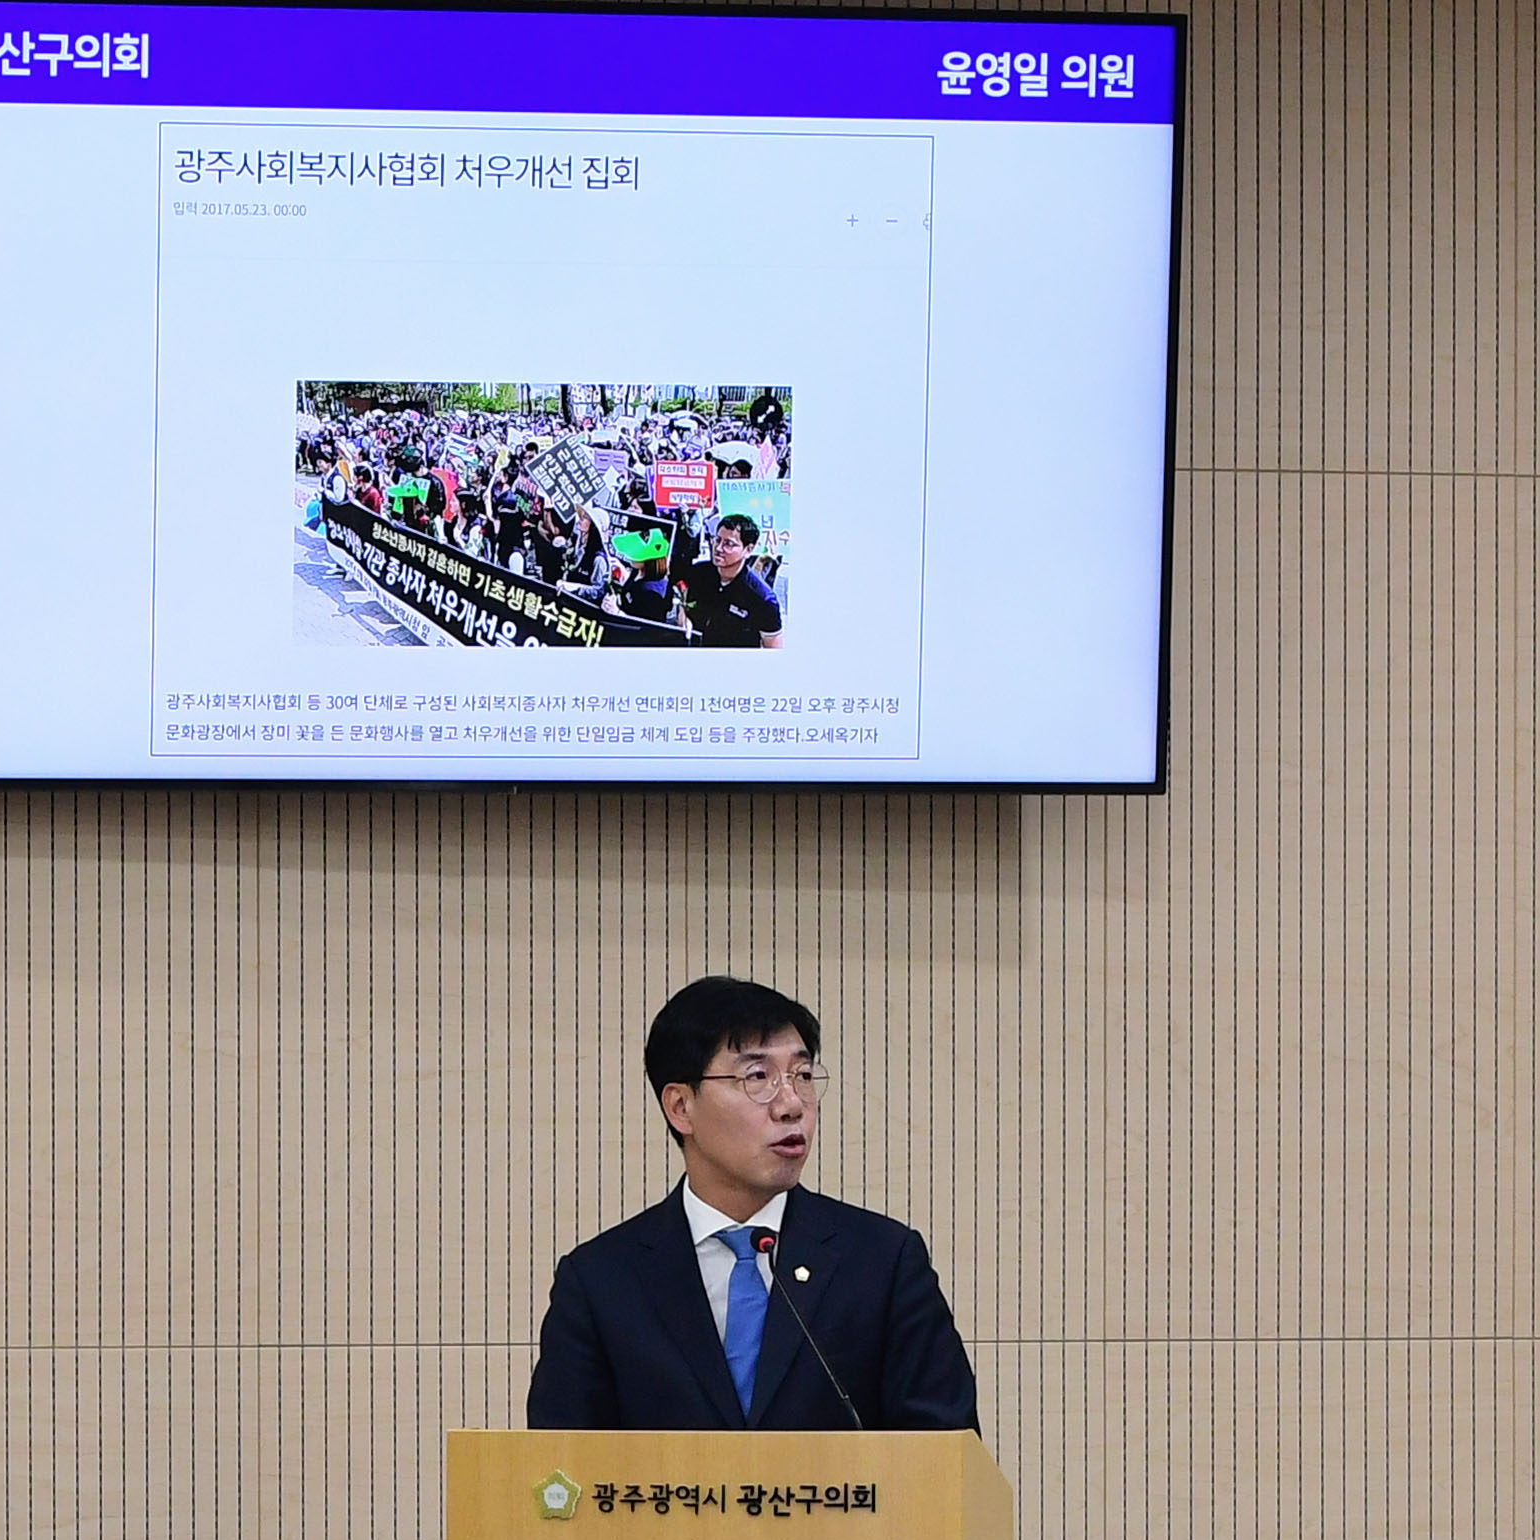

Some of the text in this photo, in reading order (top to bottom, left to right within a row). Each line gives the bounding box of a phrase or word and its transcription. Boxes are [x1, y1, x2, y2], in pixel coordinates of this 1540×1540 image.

[936, 51, 1134, 98] 윤영일 의원
[174, 148, 639, 190] 광주사회복지사협회 처우개선 집회
[172, 201, 307, 217] 입력 2017.05.23. 00:00
[385, 558, 427, 601] 종사자
[426, 578, 518, 646] 처우개선을
[475, 572, 605, 647] 기초생활수급자!
[165, 693, 899, 714] 광주사회복지사협회 등 30여 단체로 구성된 사회복지종사자 처우개선 연대회의 1천여명은 22일 오후 광주시청
[165, 723, 255, 741] 문화광장에서
[260, 723, 290, 741] 장미
[295, 724, 324, 741] 꽃을
[329, 724, 344, 741] 든
[348, 724, 424, 742] 문화행사를
[428, 724, 458, 742] 열고
[462, 724, 537, 742] 처우개선을
[541, 725, 571, 742] 위한
[575, 725, 635, 742] 단일임금
[639, 725, 670, 742] 체계
[673, 726, 702, 743] 도입
[707, 726, 737, 743] 등을
[591, 1482, 877, 1517] 광주광역시 광산구의회
